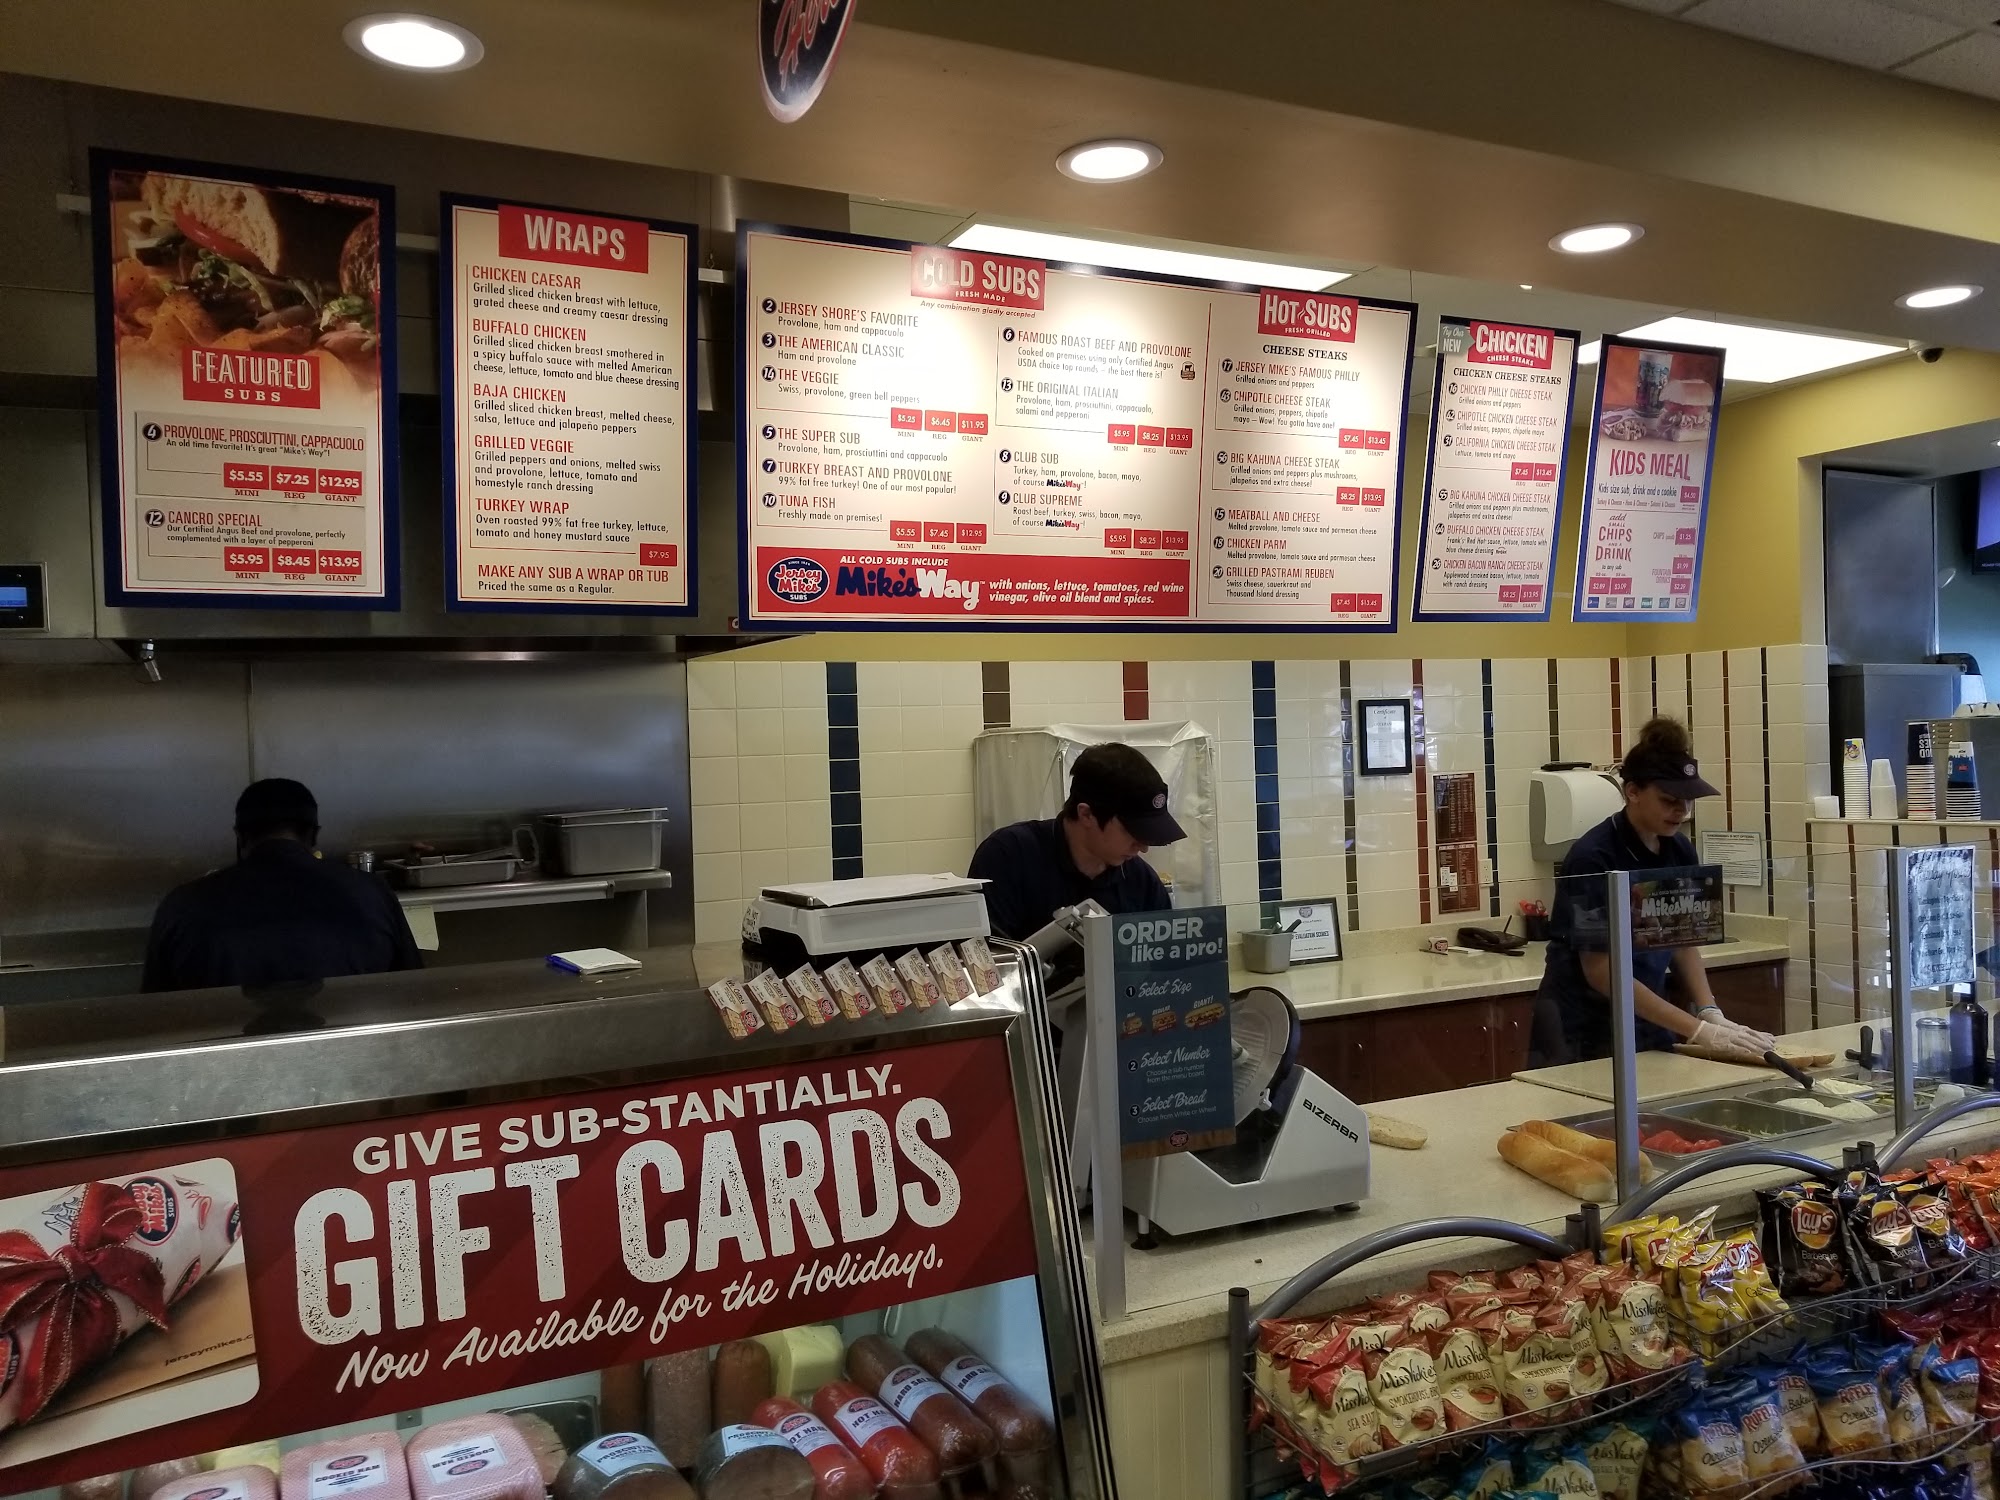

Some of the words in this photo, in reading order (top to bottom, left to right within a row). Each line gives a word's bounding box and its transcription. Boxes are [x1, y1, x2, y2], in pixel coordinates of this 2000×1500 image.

[523, 213, 626, 261] WRAPS
[472, 265, 526, 284] CHICKEN
[531, 271, 581, 289] CAESAR
[919, 254, 974, 289] COLD
[982, 260, 1041, 300] SUBS
[473, 282, 505, 294] Grilled
[508, 286, 534, 299] sliced
[537, 288, 572, 301] chicken
[575, 291, 603, 304] breast
[606, 296, 625, 307] with
[628, 297, 660, 313] lettuce,
[955, 290, 980, 298] FRESH
[983, 293, 1006, 303] MADE
[777, 301, 818, 316] JERSEY
[821, 306, 866, 321] SHORE'S
[870, 311, 918, 327] FAVORITE
[1264, 294, 1299, 325] HOT
[1304, 298, 1352, 334] SUBS
[472, 318, 528, 335] BUFFALO
[533, 324, 586, 341] CHICKEN
[1306, 328, 1331, 338] GRILLED
[777, 334, 798, 348] THE
[801, 337, 858, 353] AMERICAN
[862, 343, 904, 358] CLASSIC
[1443, 339, 1461, 352] NEW
[1475, 325, 1548, 360] CHICKEN
[1262, 344, 1305, 357] CHEESE
[1307, 348, 1348, 361] STEAKS
[1512, 356, 1534, 366] STEAKS
[191, 350, 312, 391] FEATURED
[1454, 368, 1492, 379] CHICKEN
[1495, 371, 1528, 382] CHEESE
[1530, 375, 1561, 385] STEAKS
[224, 388, 282, 403] SUBS
[473, 383, 508, 398] BAJA
[513, 386, 566, 402] CHICKEN
[163, 425, 227, 442] PROVOLONE,
[229, 429, 299, 448] PROSCIUTTINI,
[301, 434, 364, 451] CAPPACUOLO
[474, 435, 525, 452] GRILLED
[529, 438, 574, 453] VEGGIE
[777, 427, 798, 440] THE
[801, 429, 835, 442] SUPER
[839, 431, 860, 444] SUB
[777, 461, 820, 474] TURKEY
[823, 463, 864, 477] BREAST
[867, 466, 889, 478] AND
[893, 468, 952, 482] PROVOLONE
[1609, 449, 1645, 477] KIDS
[1650, 453, 1690, 481] MEAL
[229, 470, 263, 483] $5.55
[276, 473, 310, 486] $7.25
[320, 476, 360, 489] $12.95
[1598, 483, 1608, 492] Kids
[1610, 484, 1619, 493] size
[1621, 484, 1630, 496] sub,
[1632, 485, 1645, 494] drink
[1646, 486, 1655, 495] and
[1661, 486, 1676, 496] cookie
[475, 498, 525, 512] TURKEY
[529, 500, 569, 514] WRAP
[778, 494, 809, 507] TUNA
[813, 496, 835, 508] FISH
[1013, 492, 1036, 504] CLUB
[1039, 494, 1082, 506] SUPREME
[167, 510, 214, 527] CANCRO
[217, 512, 262, 528] SPECIAL
[1228, 509, 1270, 520] MEATBALL
[1272, 511, 1290, 521] AND
[1292, 512, 1320, 522] CHEESE
[167, 524, 180, 532] Our
[183, 524, 214, 533] Certified
[216, 526, 239, 536] Angus
[241, 527, 257, 535] Beef
[260, 528, 273, 536] and
[275, 529, 314, 539] provolone,
[315, 530, 346, 540] perfectly
[896, 528, 916, 537] $5.55
[929, 528, 949, 538] $7.45
[961, 529, 983, 537] $12.95
[1599, 526, 1632, 542] CHIPS
[1227, 538, 1261, 548] CHICKEN
[1263, 539, 1286, 549] PARM
[229, 553, 263, 566] $5.95
[277, 555, 310, 568] $8.45
[320, 555, 360, 569] $13.95
[648, 550, 670, 559] $7.95
[839, 555, 856, 563] ALL
[858, 555, 883, 564] COLD
[885, 556, 909, 565] SUBS
[911, 557, 949, 566] INCLUDE
[1595, 545, 1632, 562] DRINK
[478, 564, 515, 577] MAKE
[518, 565, 544, 578] ANY
[548, 566, 572, 579] SUB
[575, 567, 584, 579] A
[587, 568, 624, 580] WRAP
[628, 569, 643, 581] OR
[646, 569, 668, 582] TUB
[775, 564, 823, 583] Jersey
[1226, 567, 1258, 577] GRILLED
[1261, 567, 1302, 577] PASTRAMI
[1305, 568, 1334, 578] REUBEN
[777, 579, 821, 593] Mike's
[989, 579, 1012, 589] with
[1015, 579, 1050, 592] onions,
[1053, 580, 1089, 592] lettuce,
[1093, 582, 1140, 593] tomatoes,
[1142, 582, 1160, 592] red
[1161, 582, 1184, 592] wine
[989, 592, 1029, 604] vinegar,
[1032, 593, 1057, 602] olive
[1059, 593, 1072, 602] oil
[1074, 593, 1101, 602] blend
[1103, 594, 1121, 603] and
[1123, 594, 1154, 606] spices.
[1117, 917, 1204, 946] ORDER
[1131, 942, 1164, 964] like
[1169, 945, 1182, 959] a
[1185, 937, 1223, 961] pro!
[1138, 981, 1168, 998] Select
[1171, 979, 1192, 995] Size
[1141, 1052, 1169, 1069] Select
[1172, 1046, 1211, 1065] Number
[1142, 1096, 1173, 1113] Select
[1175, 1090, 1207, 1110] Bread
[353, 1123, 483, 1175] GIVE
[499, 1064, 902, 1155] SUB-STANTIALLY.
[1302, 1098, 1359, 1143] BIZERBA
[294, 1154, 580, 1346] GIFT
[616, 1097, 961, 1283] CARDS
[1796, 1208, 1833, 1234] Lay's
[336, 1345, 429, 1393] Now
[443, 1298, 645, 1371] Available
[649, 1286, 712, 1345] for
[721, 1270, 779, 1311] the
[787, 1243, 943, 1300] Holidays.
[957, 1370, 978, 1390] HARD
[893, 1384, 912, 1408] HARD
[852, 1410, 870, 1428] HOT
[315, 1470, 354, 1483] COOKED
[356, 1464, 380, 1475] HAM
